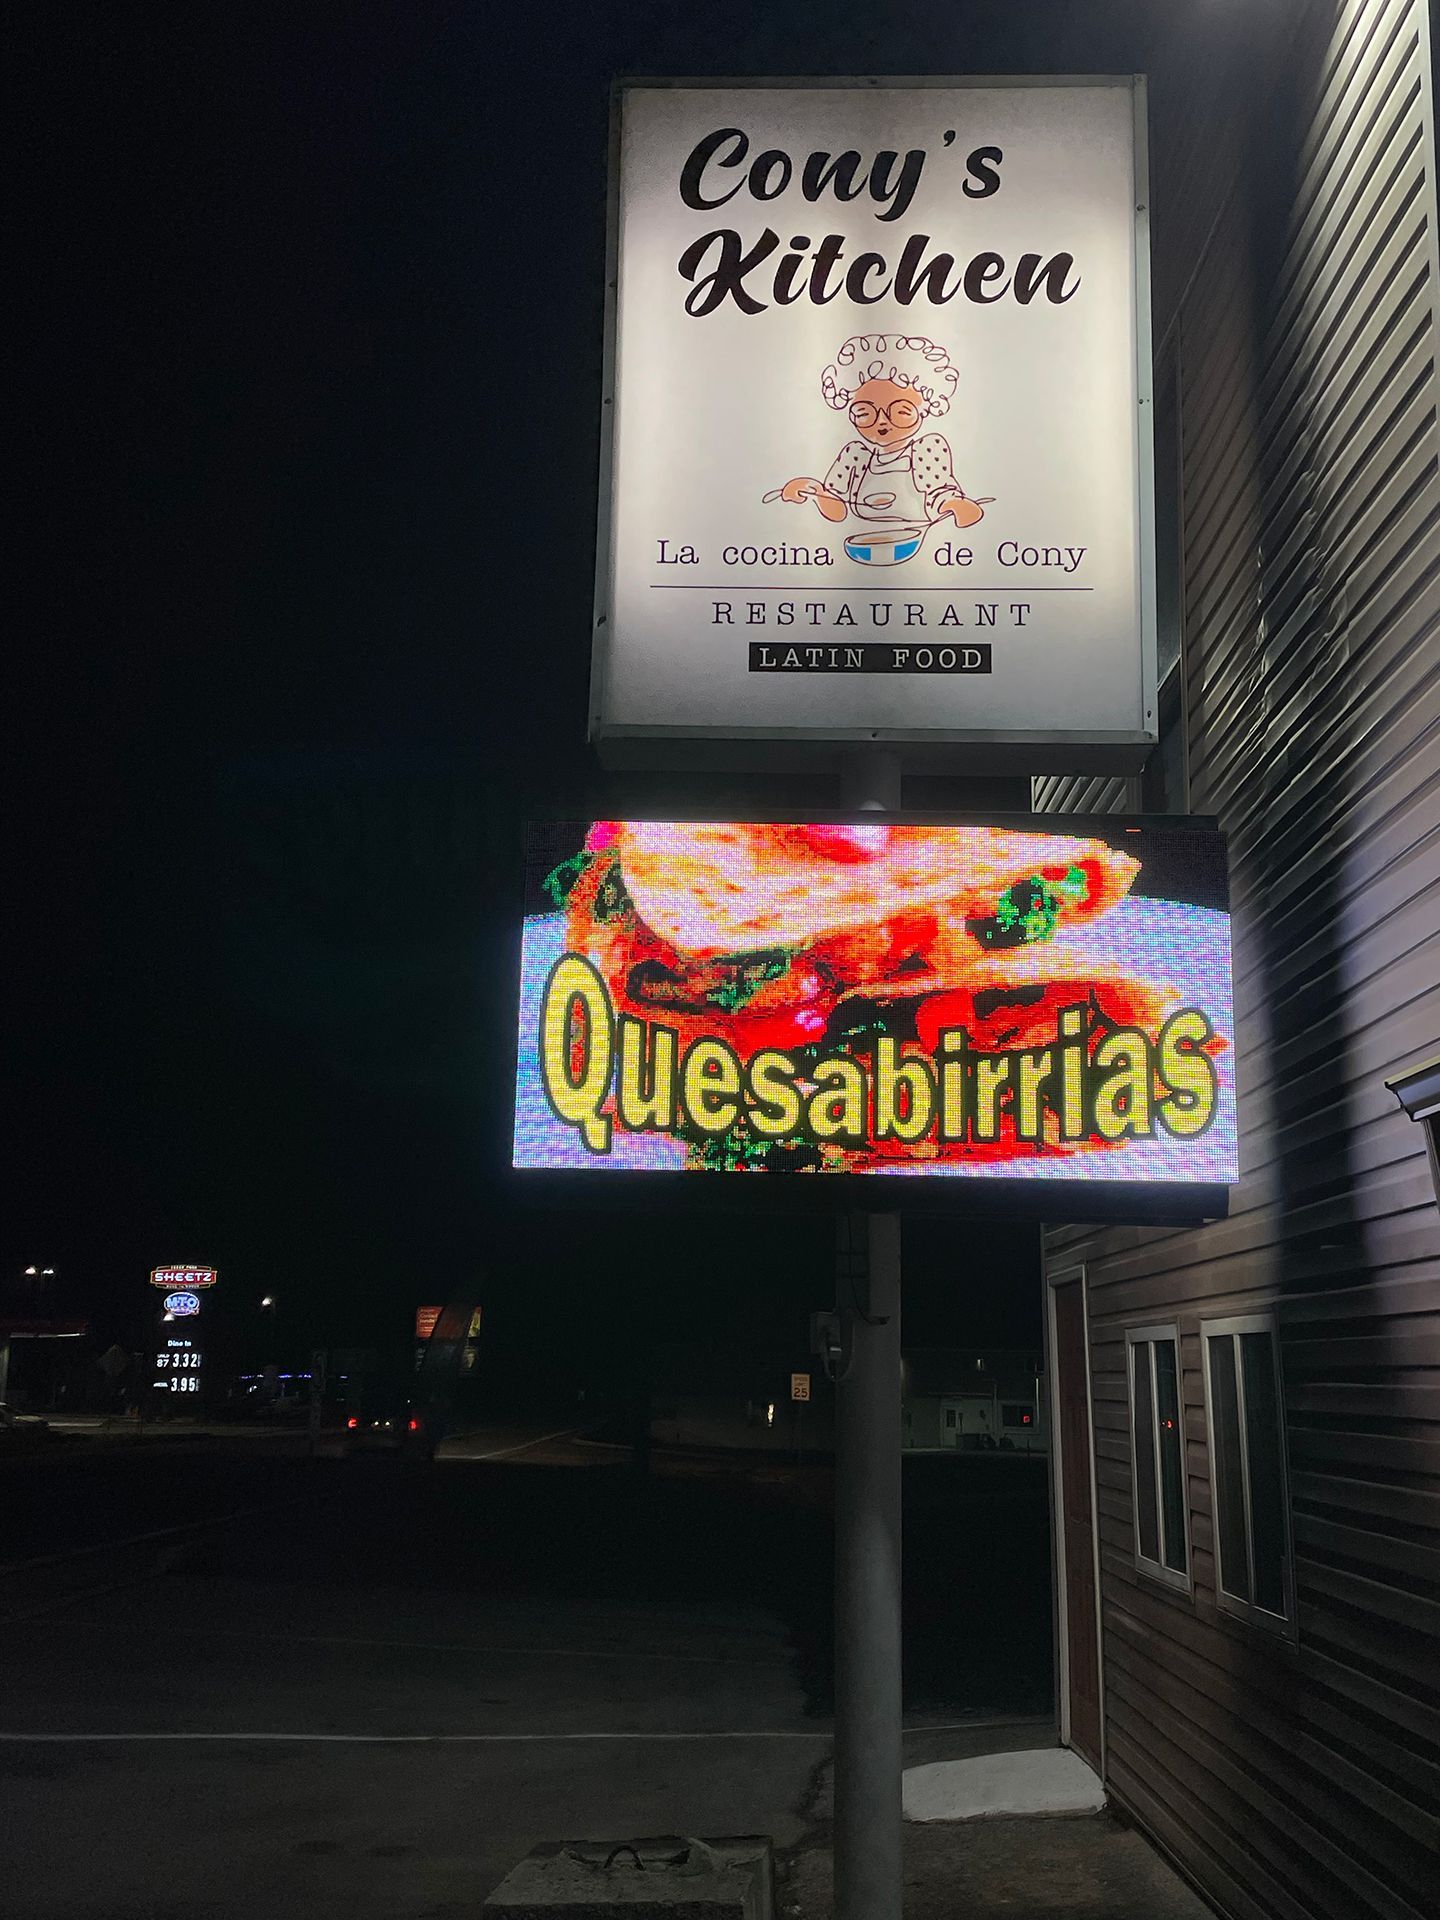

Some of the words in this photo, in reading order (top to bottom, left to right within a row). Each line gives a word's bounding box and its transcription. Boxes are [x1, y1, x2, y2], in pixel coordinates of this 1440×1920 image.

[679, 127, 1003, 222] Cony's
[678, 227, 1081, 317] Kitchen
[656, 539, 700, 565] La
[722, 541, 834, 566] cocina
[934, 540, 973, 567] de
[997, 540, 1087, 573] Cony
[711, 602, 1032, 627] RESTAURANT
[759, 647, 865, 668] LATIN
[892, 648, 983, 669] FOOD
[542, 951, 1221, 1154] Quesabirrias
[154, 1272, 212, 1282] SHEETZ
[156, 1359, 170, 1368] 87
[172, 1353, 197, 1368] 3.32
[170, 1377, 196, 1392] 3.95
[793, 1387, 808, 1398] 25
